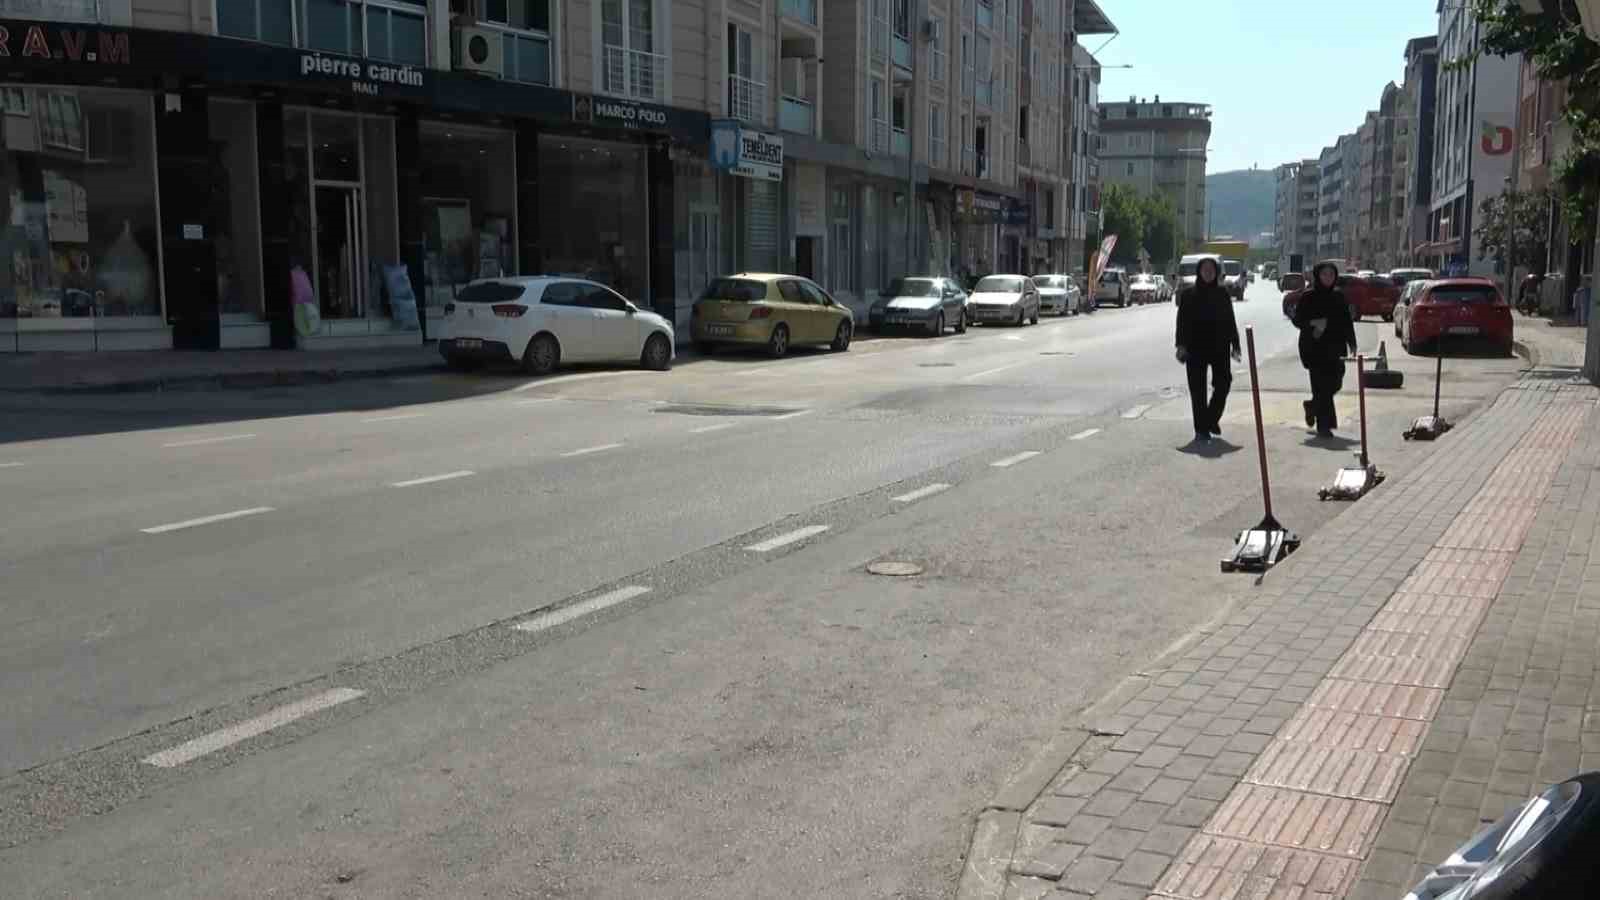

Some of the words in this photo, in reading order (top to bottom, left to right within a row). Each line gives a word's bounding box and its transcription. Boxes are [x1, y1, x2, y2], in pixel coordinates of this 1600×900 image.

[301, 52, 361, 77] pierre
[367, 64, 424, 86] cardin
[596, 103, 636, 120] MARCO
[638, 109, 667, 124] POLO
